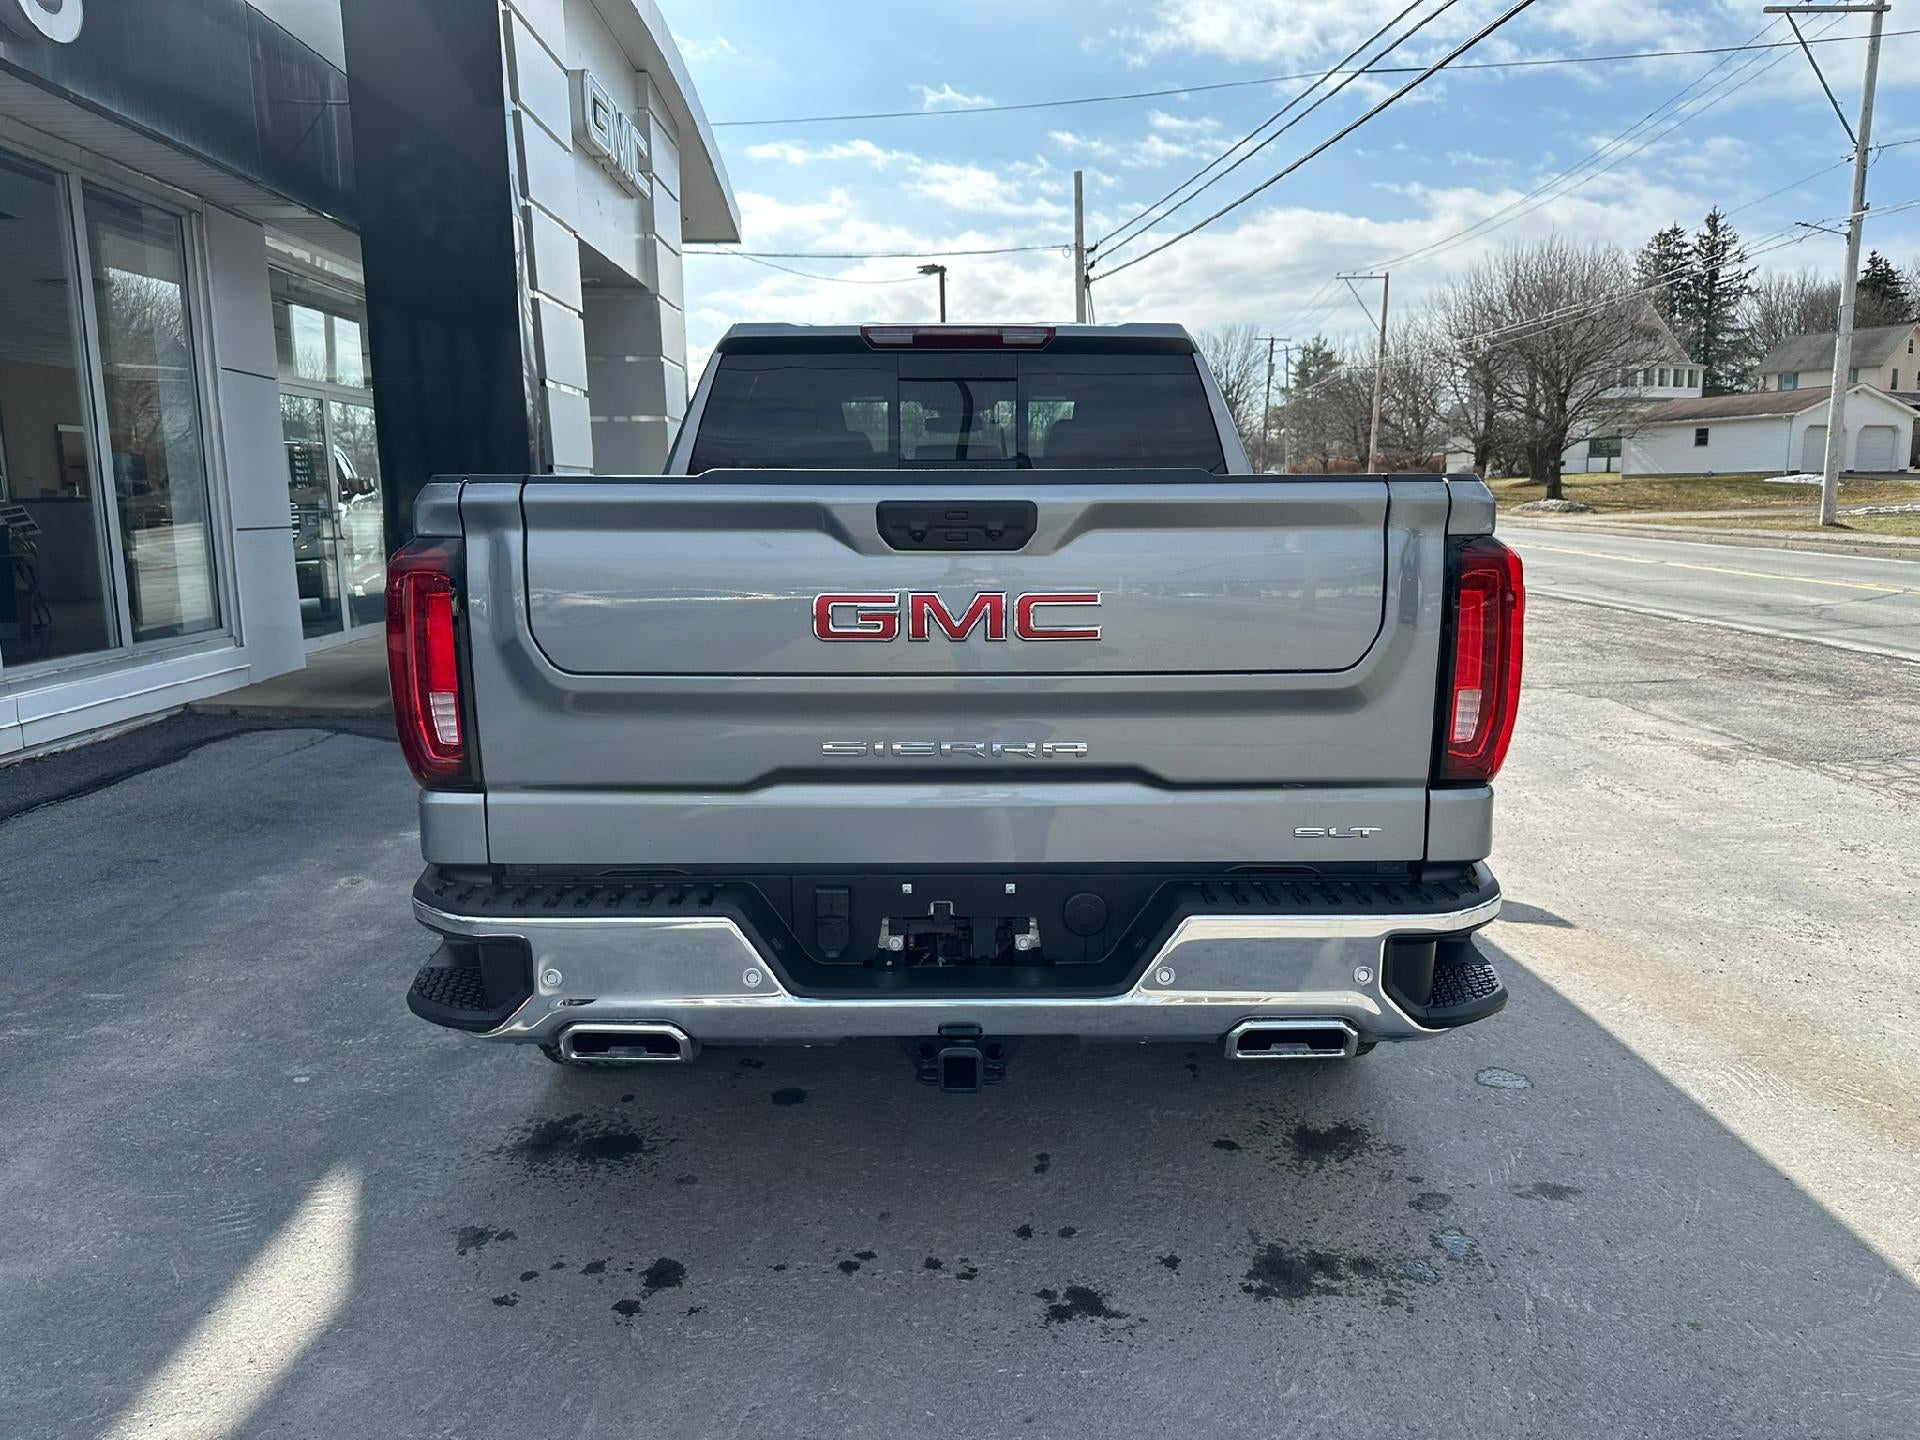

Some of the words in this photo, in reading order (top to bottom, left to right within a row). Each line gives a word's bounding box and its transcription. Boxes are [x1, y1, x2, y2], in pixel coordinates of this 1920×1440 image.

[586, 71, 651, 199] GMC
[812, 591, 1102, 642] GMC
[821, 741, 1088, 759] SIERRA
[1293, 826, 1382, 839] SLT
